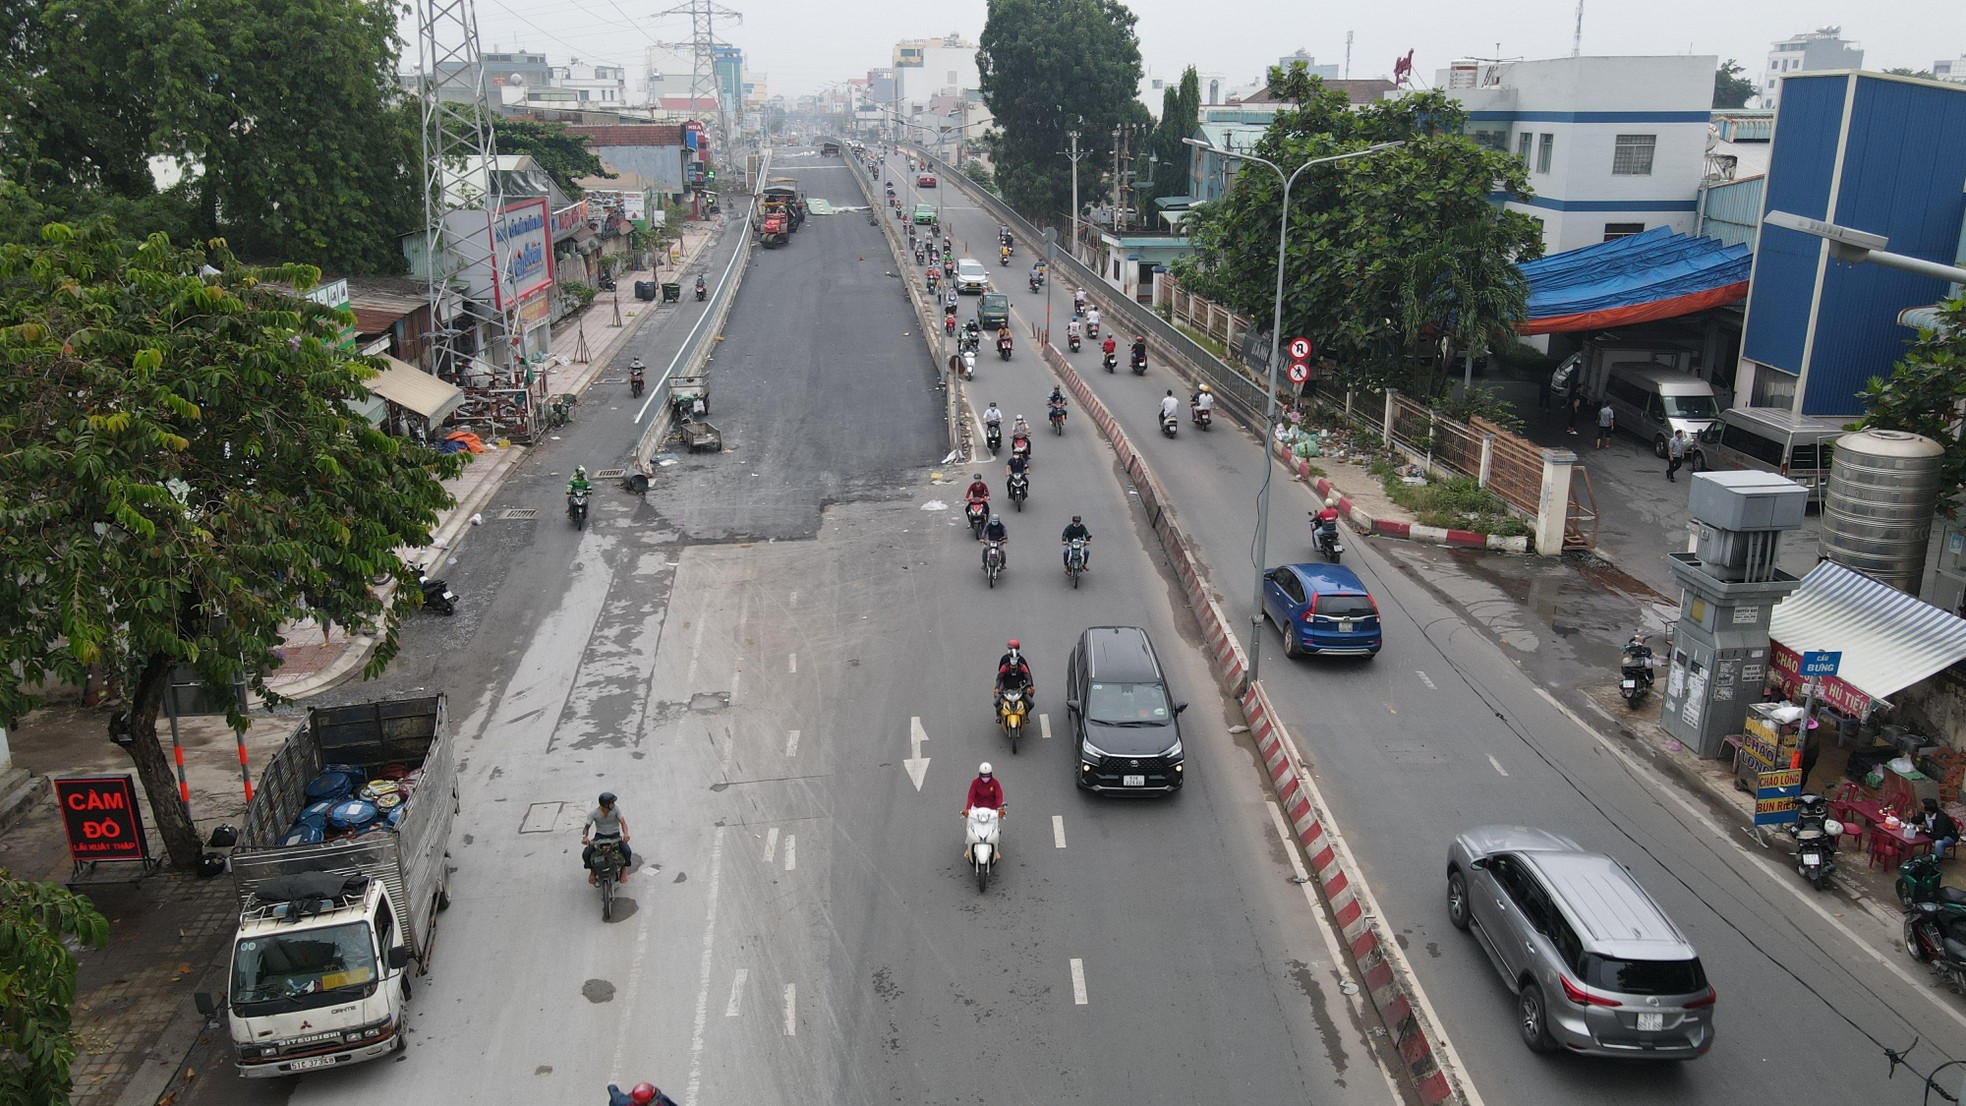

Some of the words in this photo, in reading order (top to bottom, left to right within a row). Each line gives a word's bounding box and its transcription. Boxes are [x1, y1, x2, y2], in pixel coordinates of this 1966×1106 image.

[1775, 650, 1798, 673] CHÁO
[1828, 682, 1843, 700] HỦ
[1757, 800, 1775, 813] BÚN
[278, 1031, 341, 1047] MITSUBISHI
